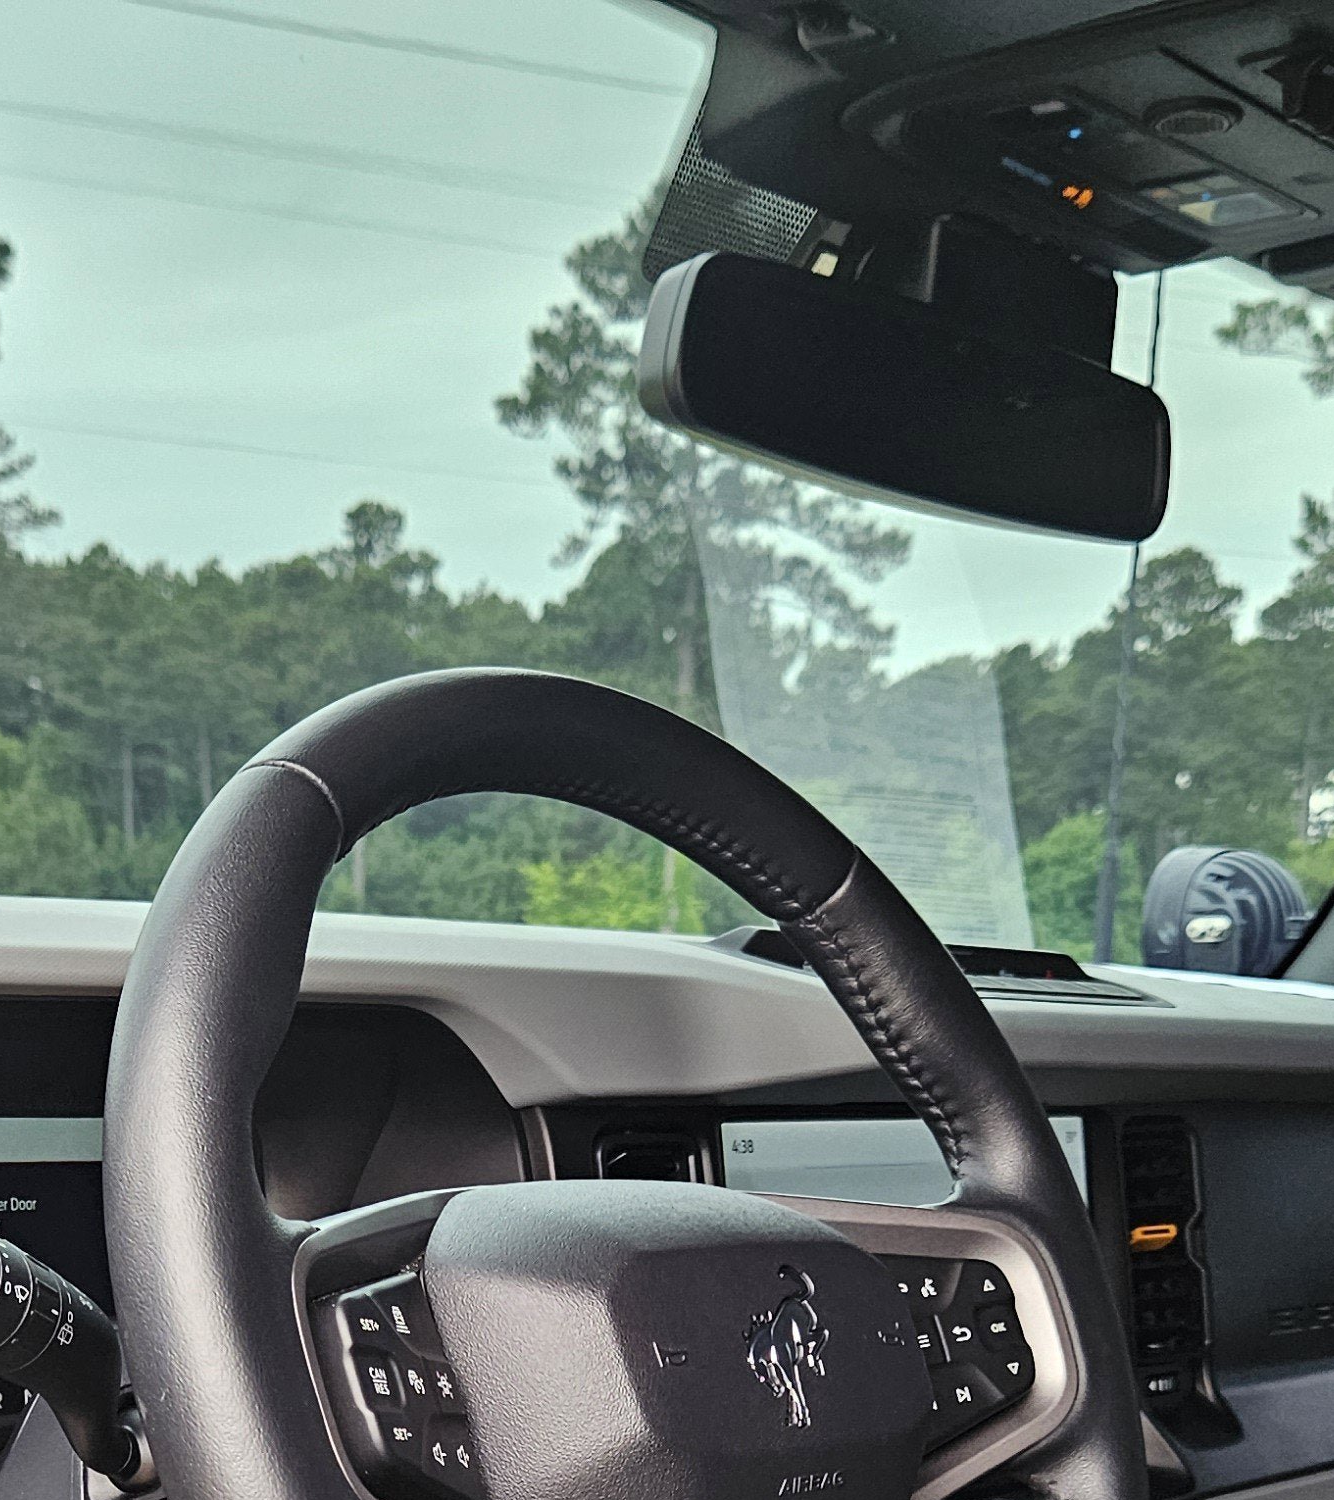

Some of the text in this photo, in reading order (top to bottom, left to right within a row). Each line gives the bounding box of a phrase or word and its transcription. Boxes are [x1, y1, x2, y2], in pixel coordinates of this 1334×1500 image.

[732, 1139, 754, 1154] 4:38
[10, 1197, 37, 1211] Door
[990, 1321, 1007, 1333] OK
[369, 1366, 387, 1380] CAN
[374, 1382, 391, 1396] RES
